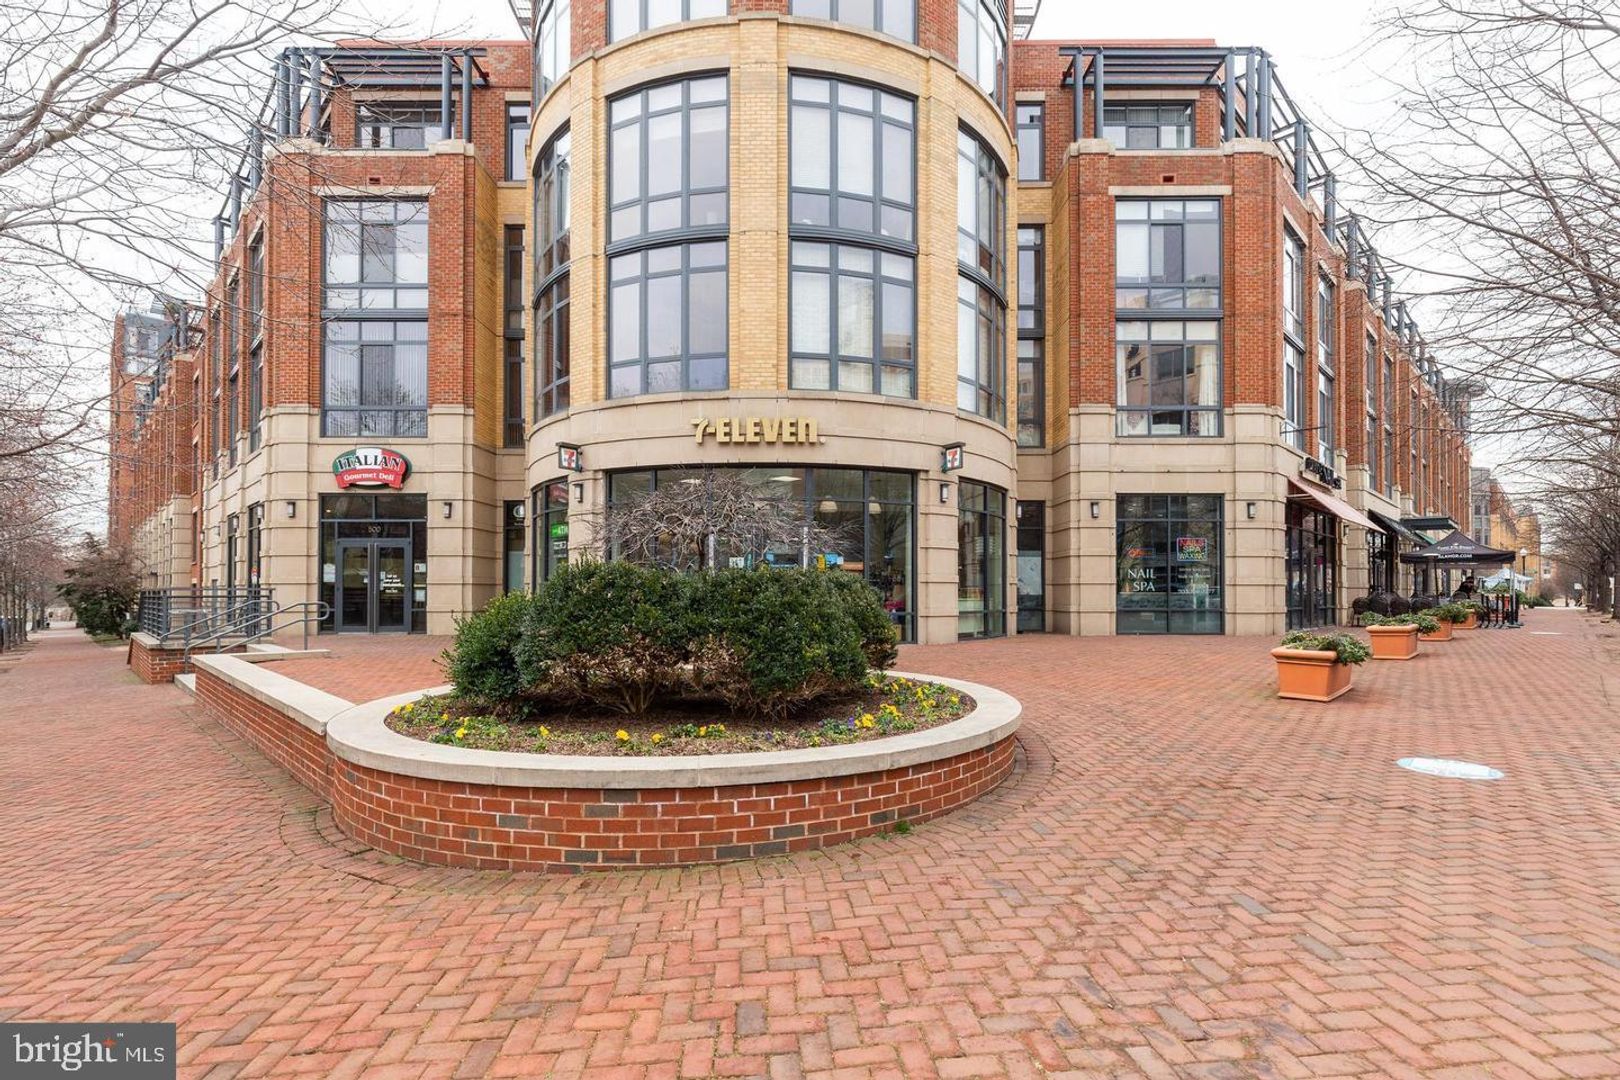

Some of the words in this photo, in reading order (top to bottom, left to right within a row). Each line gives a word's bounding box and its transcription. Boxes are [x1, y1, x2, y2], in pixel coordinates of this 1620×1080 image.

[337, 454, 402, 471] ITALIAN
[344, 473, 376, 481] Gourmet
[1183, 545, 1201, 553] SPA
[1128, 569, 1156, 579] NAIL
[1133, 581, 1155, 592] SPA
